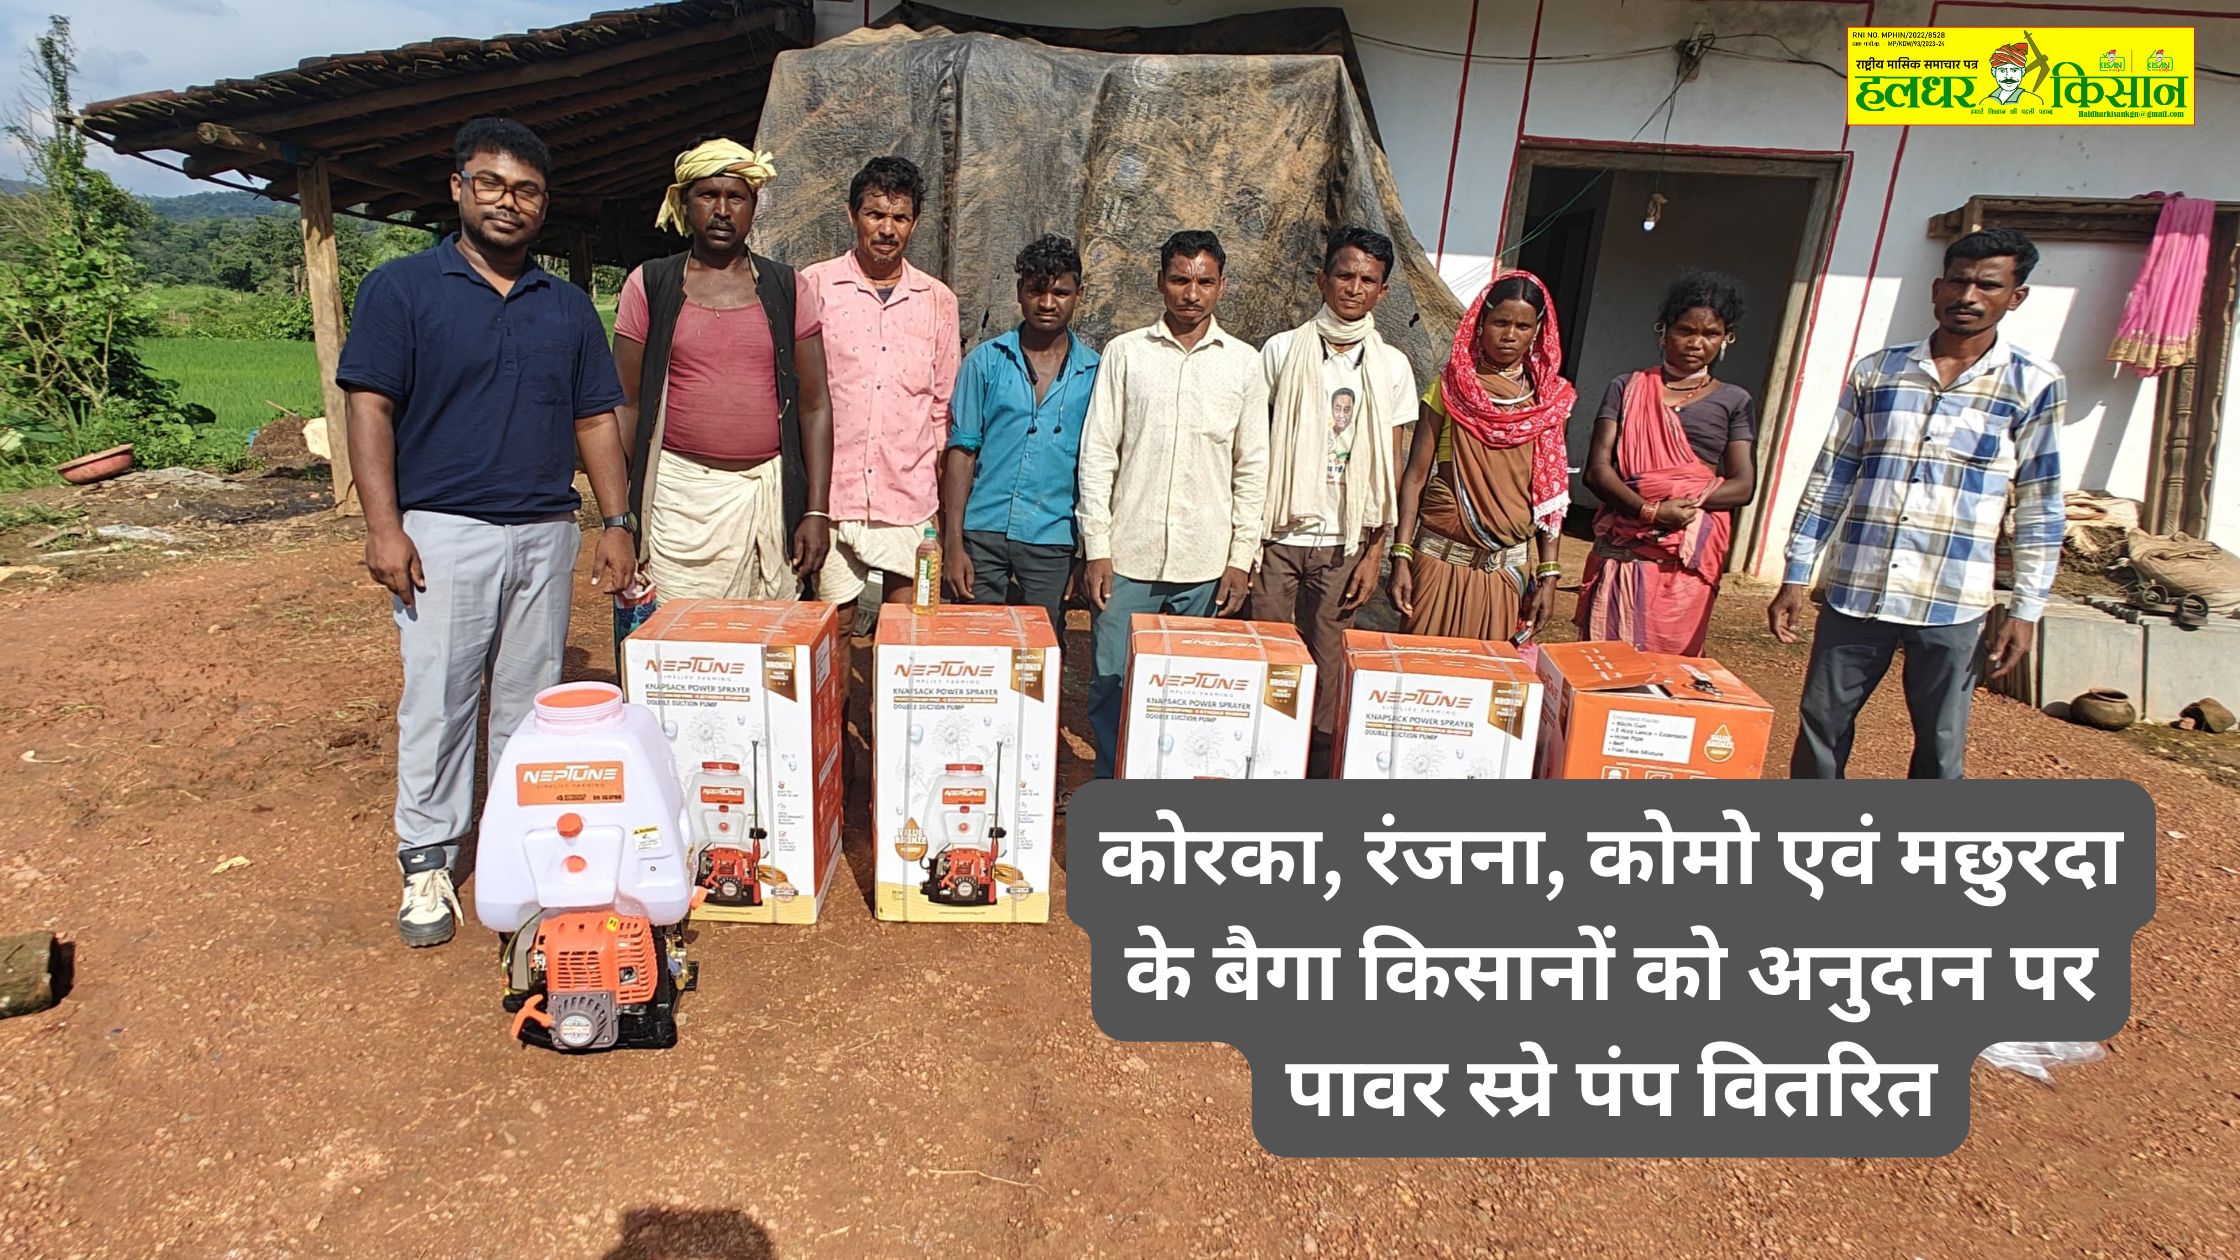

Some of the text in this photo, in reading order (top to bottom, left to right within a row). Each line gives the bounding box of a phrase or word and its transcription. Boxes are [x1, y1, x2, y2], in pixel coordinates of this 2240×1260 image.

[645, 656, 745, 675] NEPTUNE
[894, 660, 995, 677] NEPTUNE
[688, 683, 716, 693] POWER
[717, 684, 750, 694] SPRAYER
[1149, 672, 1249, 691] NEPTUNE
[935, 688, 964, 696] POWER
[965, 688, 998, 696] SPRAYER
[1368, 688, 1473, 708] NEPTUNE
[1188, 699, 1217, 708] POWER
[1218, 701, 1251, 710] SPRAYER
[1409, 716, 1439, 725] POWER
[1440, 718, 1475, 729] SPRAYER
[523, 764, 618, 784] NEPTUNE
